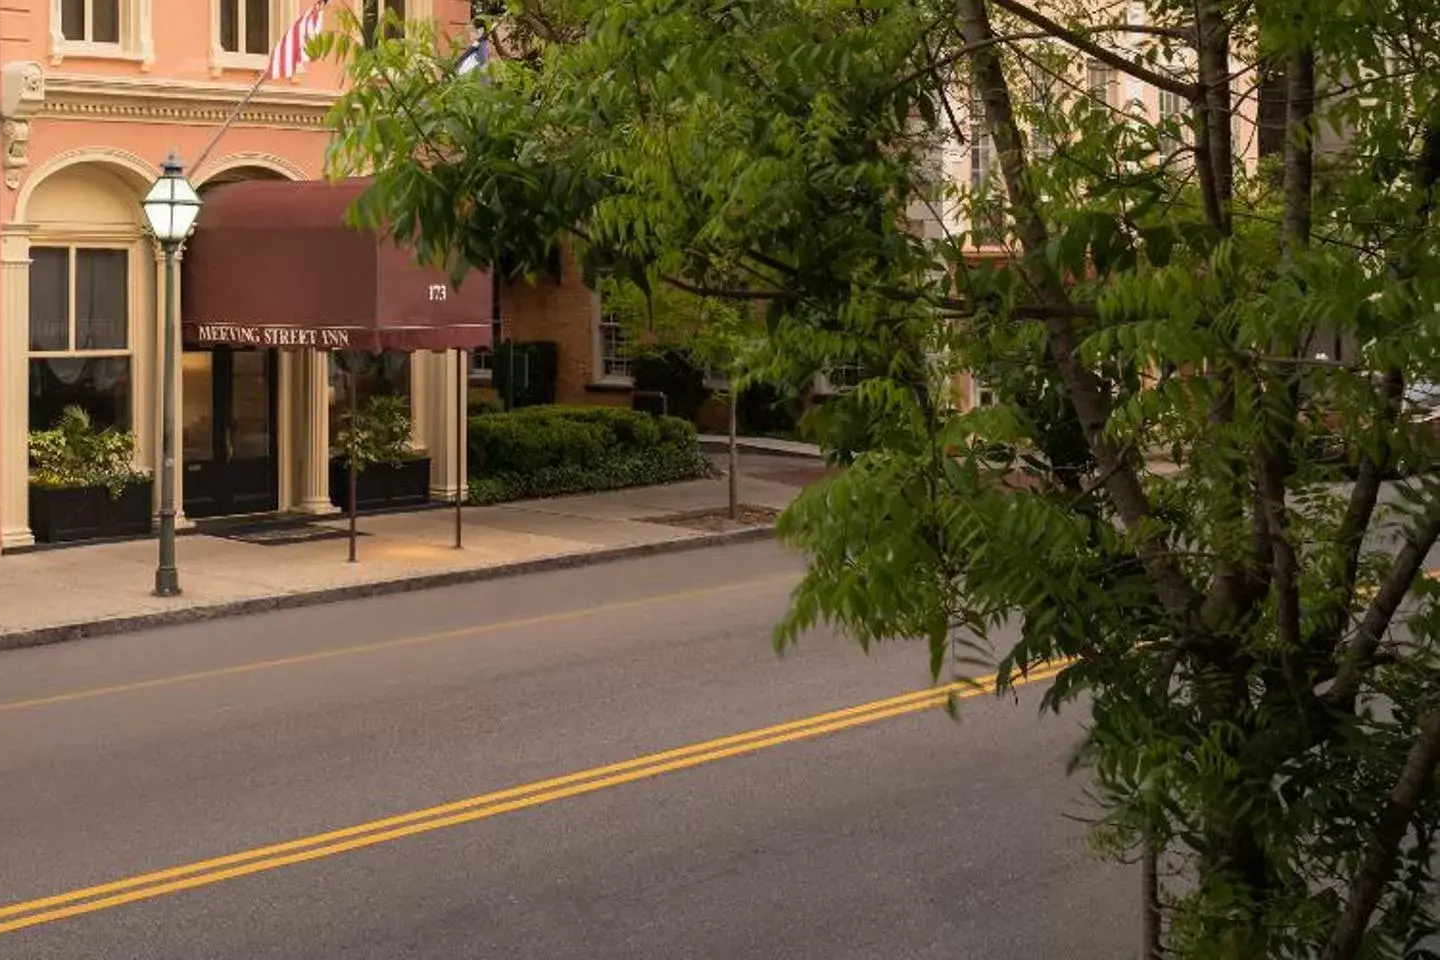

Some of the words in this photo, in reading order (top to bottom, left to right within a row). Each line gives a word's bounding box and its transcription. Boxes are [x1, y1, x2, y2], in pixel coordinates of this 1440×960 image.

[429, 284, 447, 301] 173
[198, 325, 260, 343] MEETING
[263, 327, 317, 345] STREET
[320, 328, 350, 346] INN
